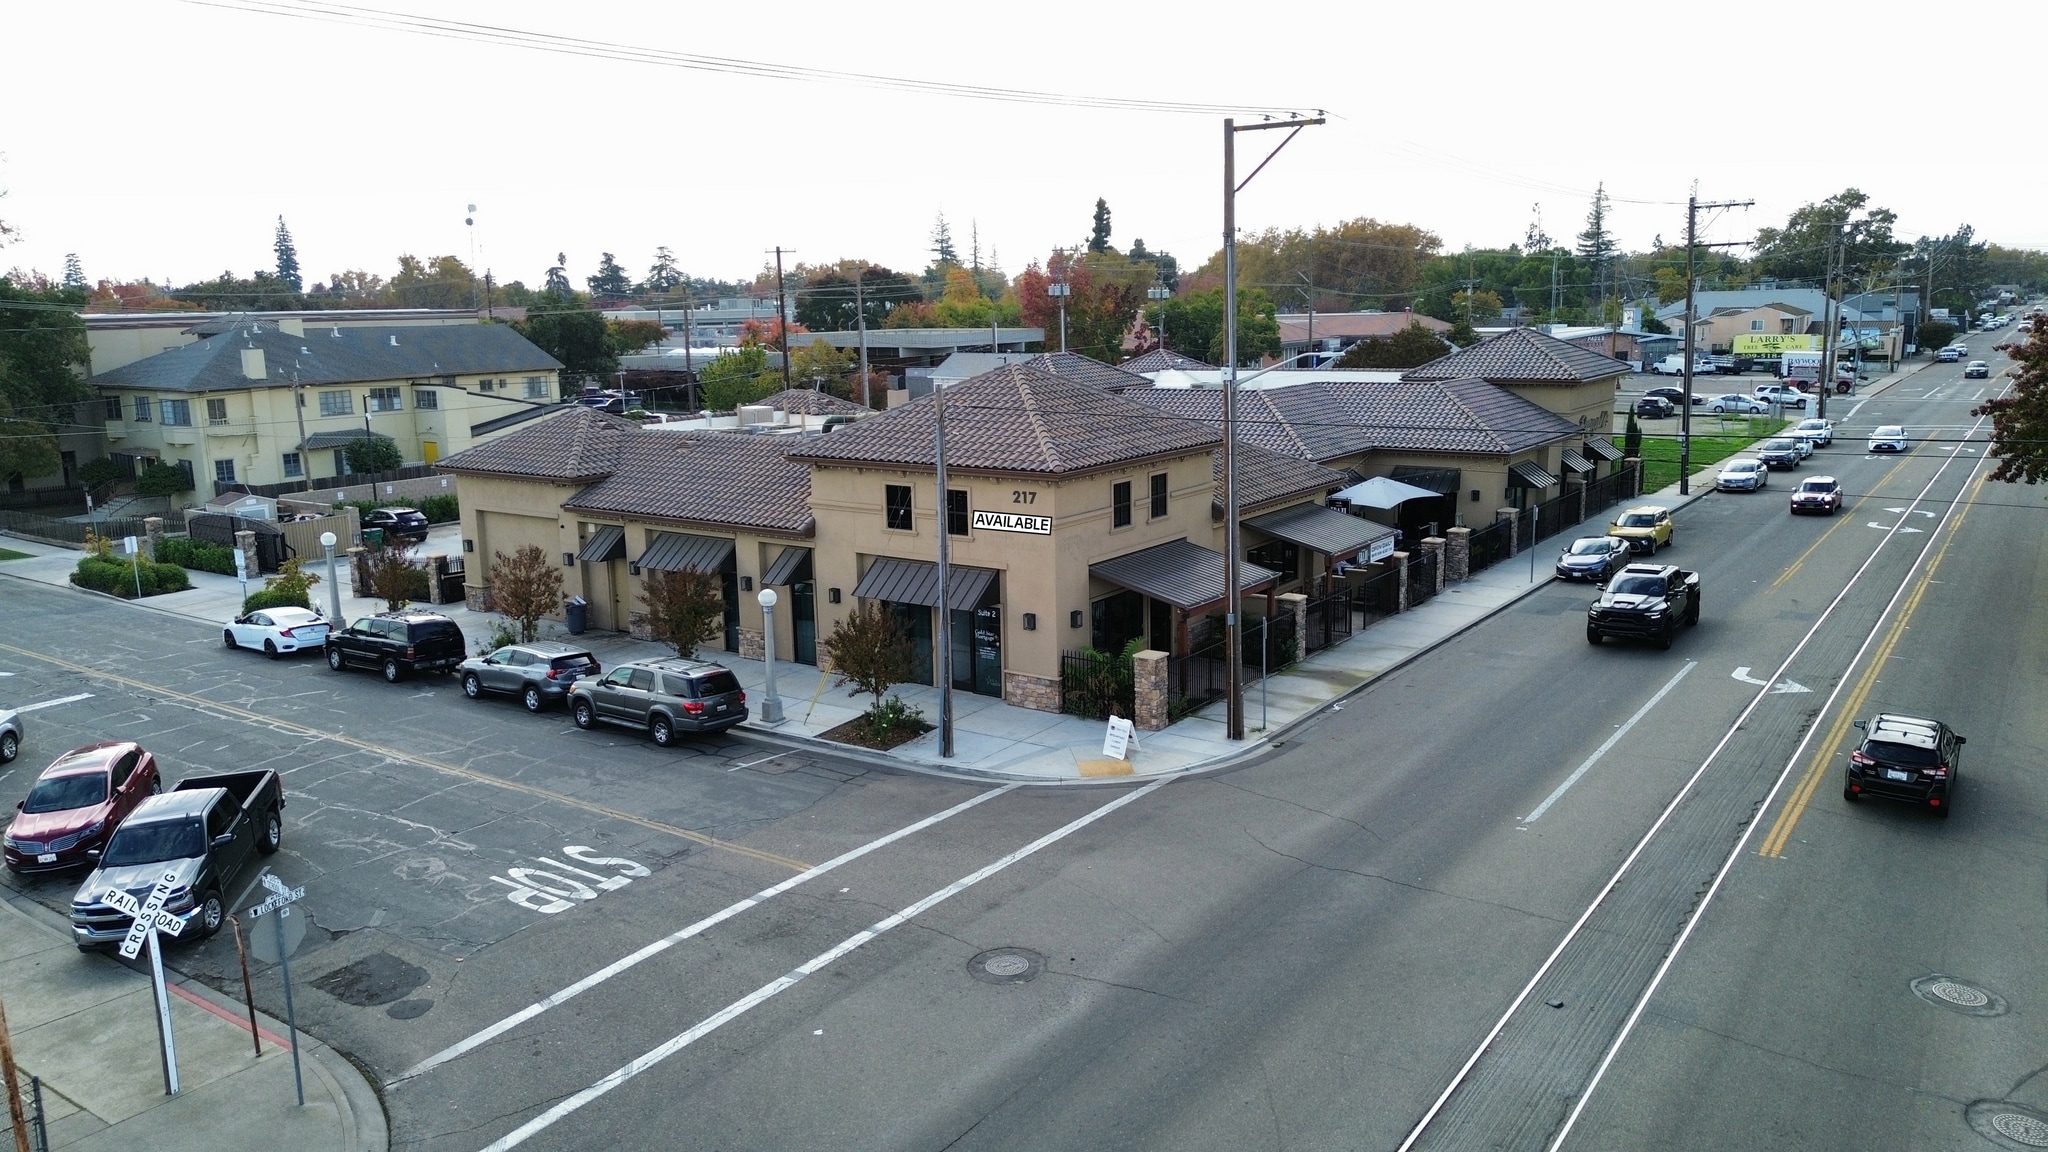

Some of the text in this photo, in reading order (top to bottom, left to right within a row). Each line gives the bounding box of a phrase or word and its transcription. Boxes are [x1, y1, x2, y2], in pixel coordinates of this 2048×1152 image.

[1012, 490, 1037, 505] 217
[975, 513, 1049, 531] AVAILABLE
[977, 609, 996, 618] Suite 2
[489, 845, 652, 914] STOP
[105, 890, 137, 914] RAIL
[260, 892, 293, 914] LOCKEFORD
[125, 873, 176, 954] CROSSING
